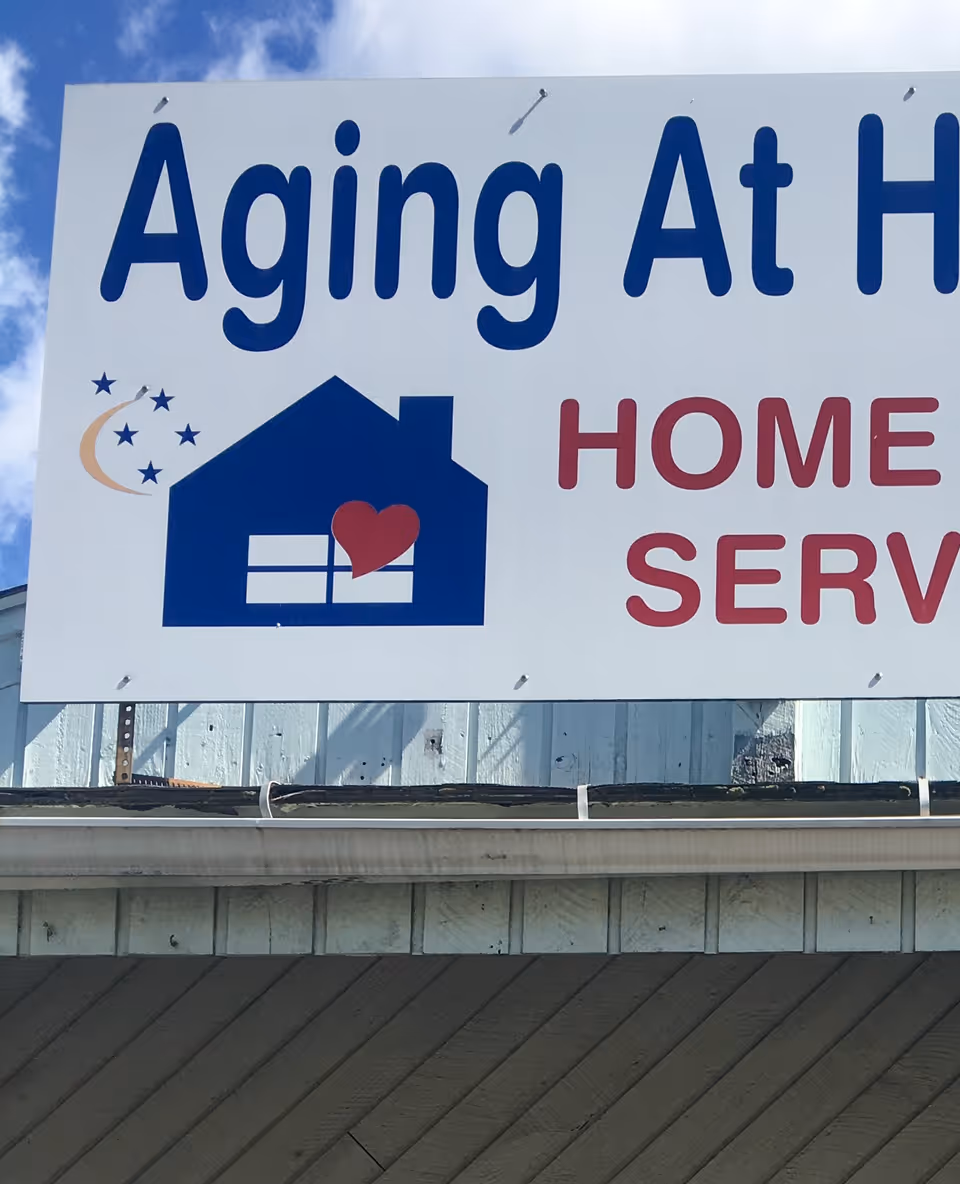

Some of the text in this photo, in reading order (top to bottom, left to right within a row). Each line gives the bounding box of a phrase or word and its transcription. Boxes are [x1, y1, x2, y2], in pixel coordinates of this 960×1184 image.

[100, 119, 563, 352] Aging
[623, 115, 794, 298] At
[558, 396, 941, 490] HOME
